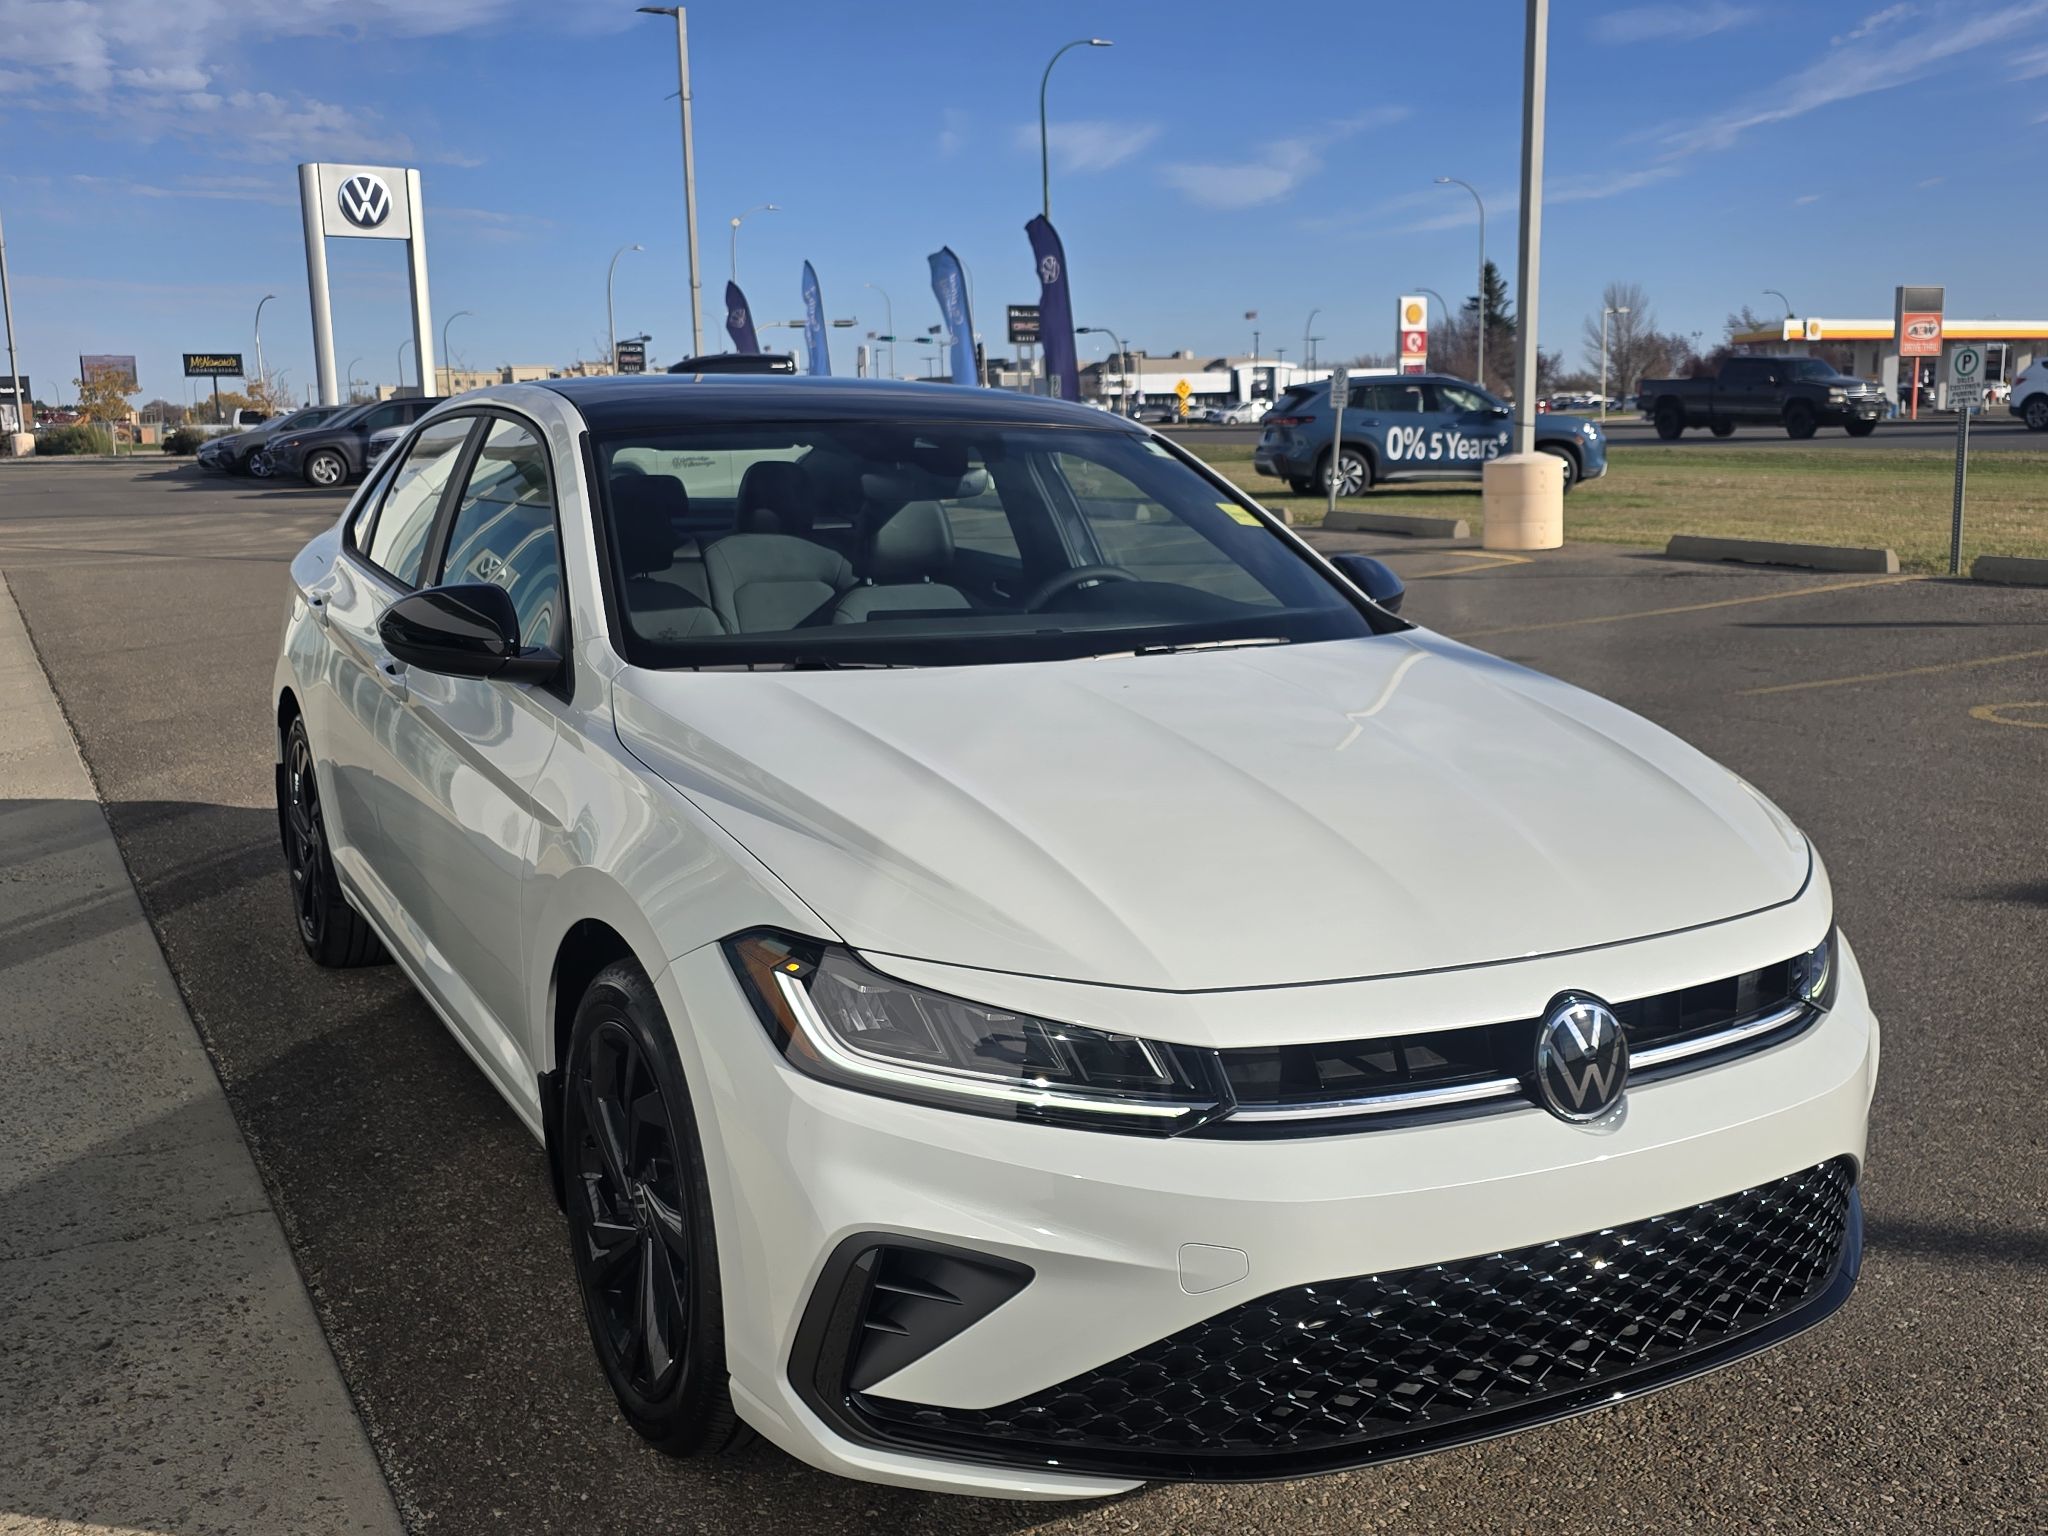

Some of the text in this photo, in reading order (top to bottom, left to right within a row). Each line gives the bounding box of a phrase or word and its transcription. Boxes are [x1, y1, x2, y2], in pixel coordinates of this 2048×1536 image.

[1962, 354, 1972, 371] P
[1386, 426, 1426, 460] 0%
[1429, 432, 1443, 460] 5
